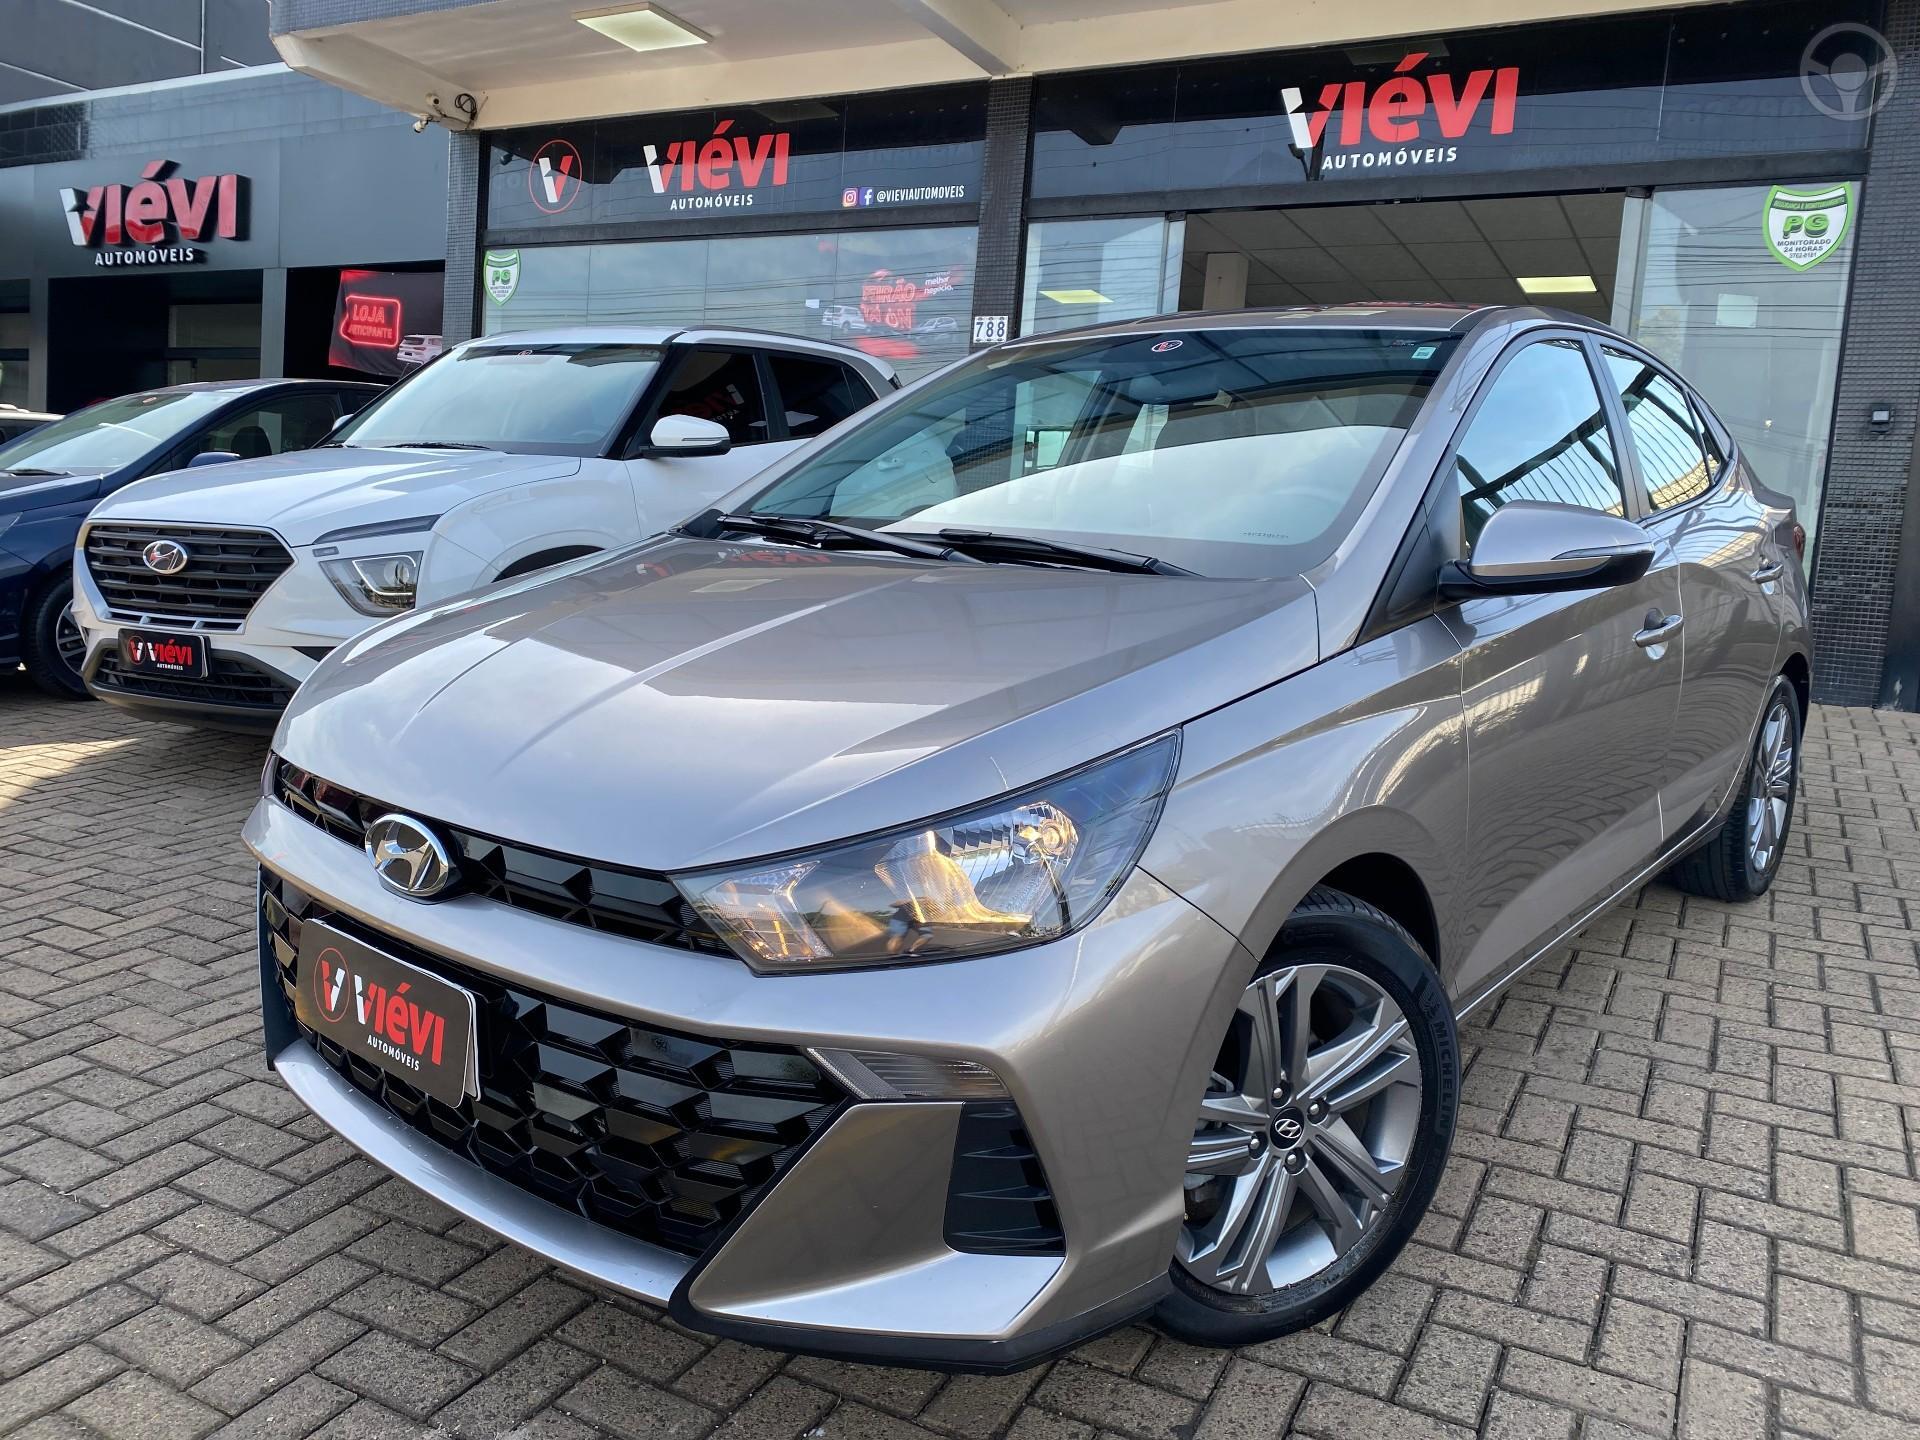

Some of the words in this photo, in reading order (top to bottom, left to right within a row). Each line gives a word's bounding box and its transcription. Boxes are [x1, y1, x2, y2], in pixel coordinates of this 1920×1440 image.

[1321, 147, 1457, 170] AUTOMÓVEIS
[669, 194, 754, 211] AUTOMÓVEIS
[876, 185, 965, 203] @VIEVIAUTOMOVEIS
[1777, 238, 1832, 247] MONITORADO
[94, 246, 196, 266] AUTOMÓVEIS
[862, 278, 916, 304] FEIRÃO
[352, 303, 385, 324] LOJA
[975, 321, 1005, 338] 788
[366, 1033, 421, 1072] AUTOMÓVEIS
[1433, 1020, 1453, 1130] MICHELIN
